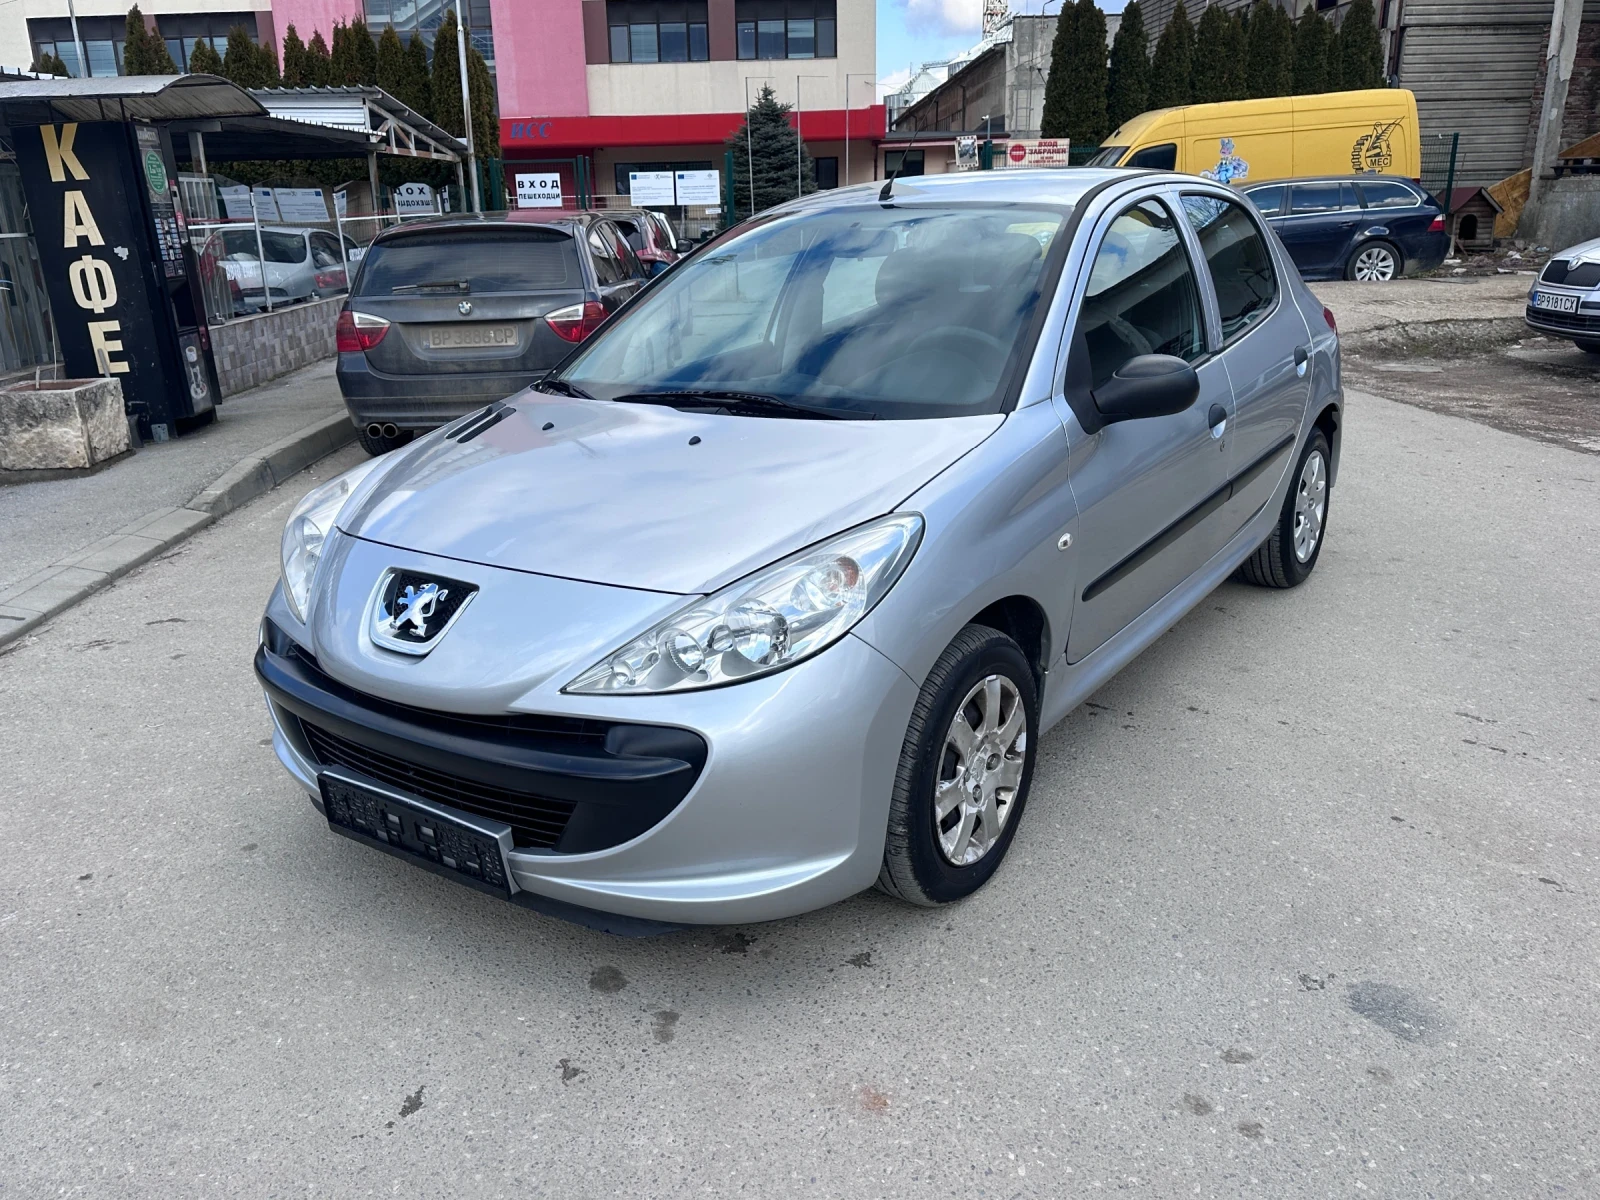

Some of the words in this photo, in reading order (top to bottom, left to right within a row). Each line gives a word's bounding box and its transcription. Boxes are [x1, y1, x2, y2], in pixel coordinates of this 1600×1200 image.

[510, 122, 552, 139] ИСС
[517, 180, 560, 190] ВХОД
[518, 192, 561, 200] ПЕШЕХОДЦИ
[39, 122, 130, 375] КАФЕ
